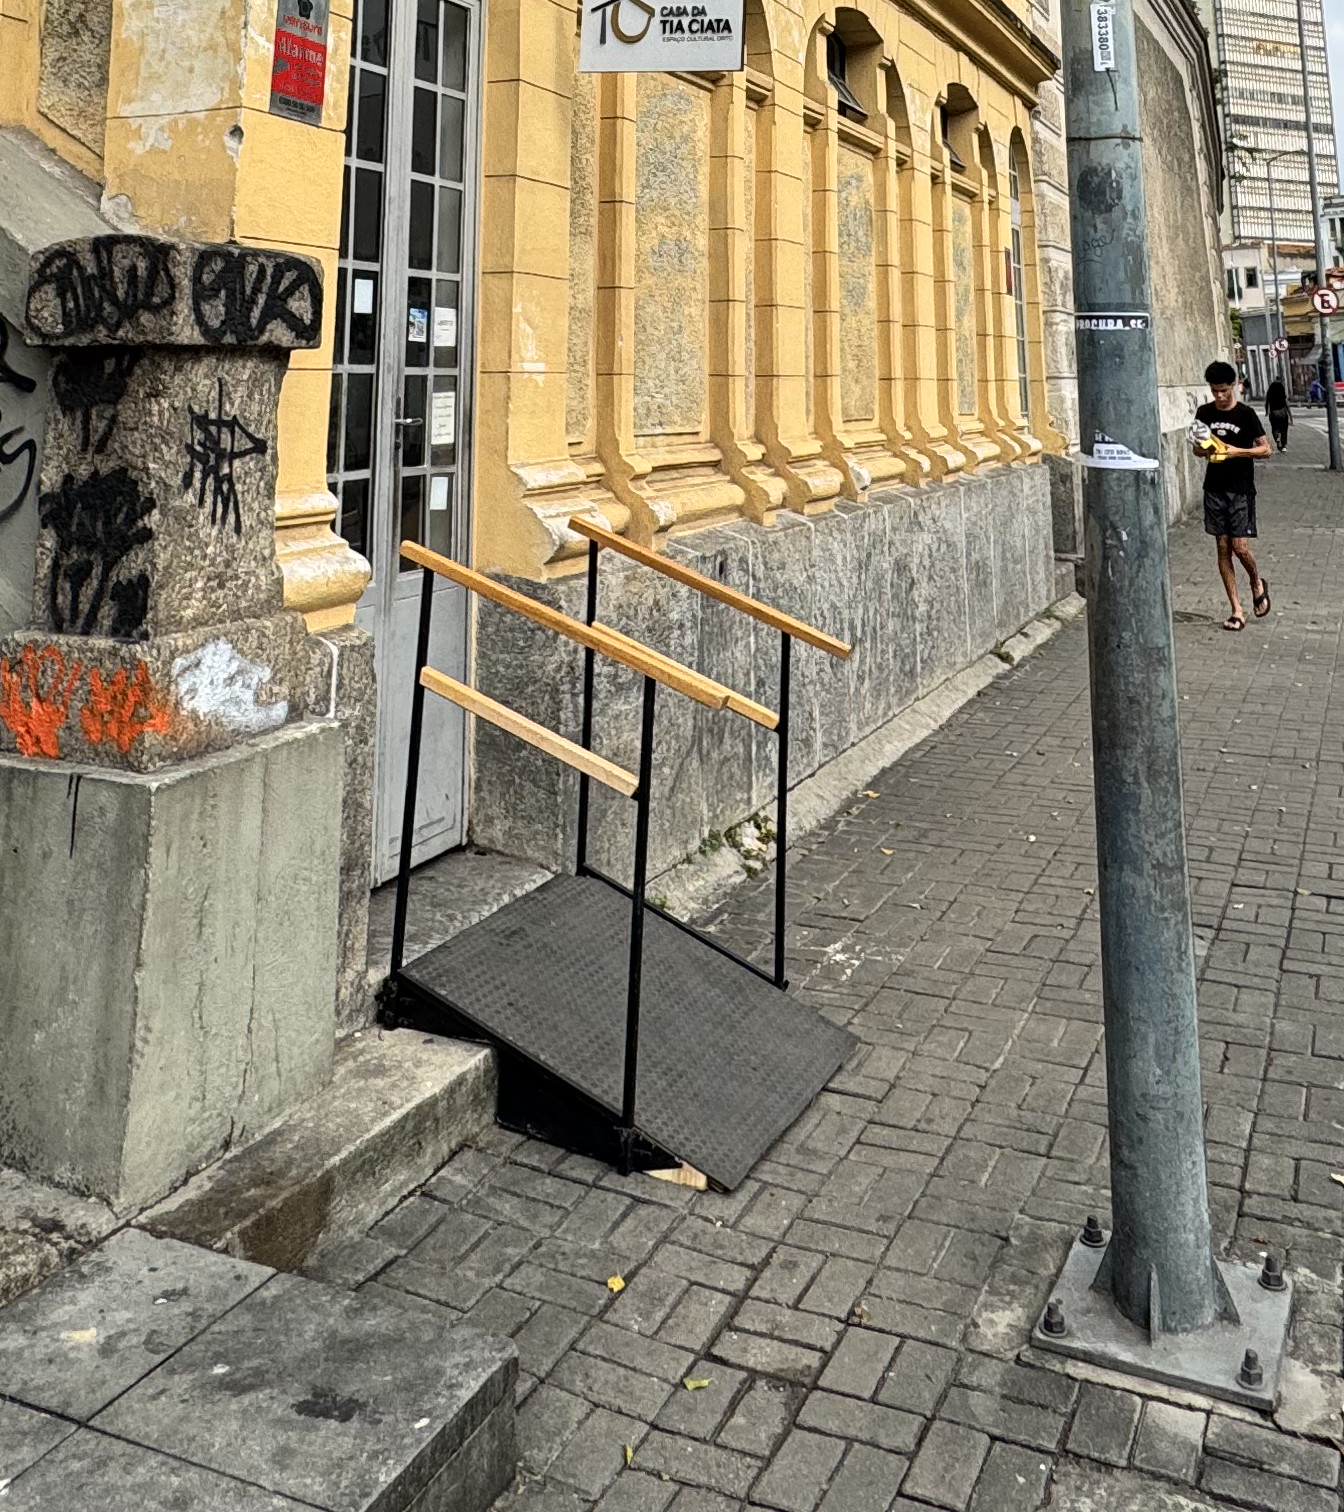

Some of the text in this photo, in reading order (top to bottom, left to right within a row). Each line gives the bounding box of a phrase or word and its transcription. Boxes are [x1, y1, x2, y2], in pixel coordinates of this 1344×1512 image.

[660, 4, 707, 17] CASA DA
[659, 18, 733, 34] TIA CIATA
[1096, 9, 1110, 51] 383380
